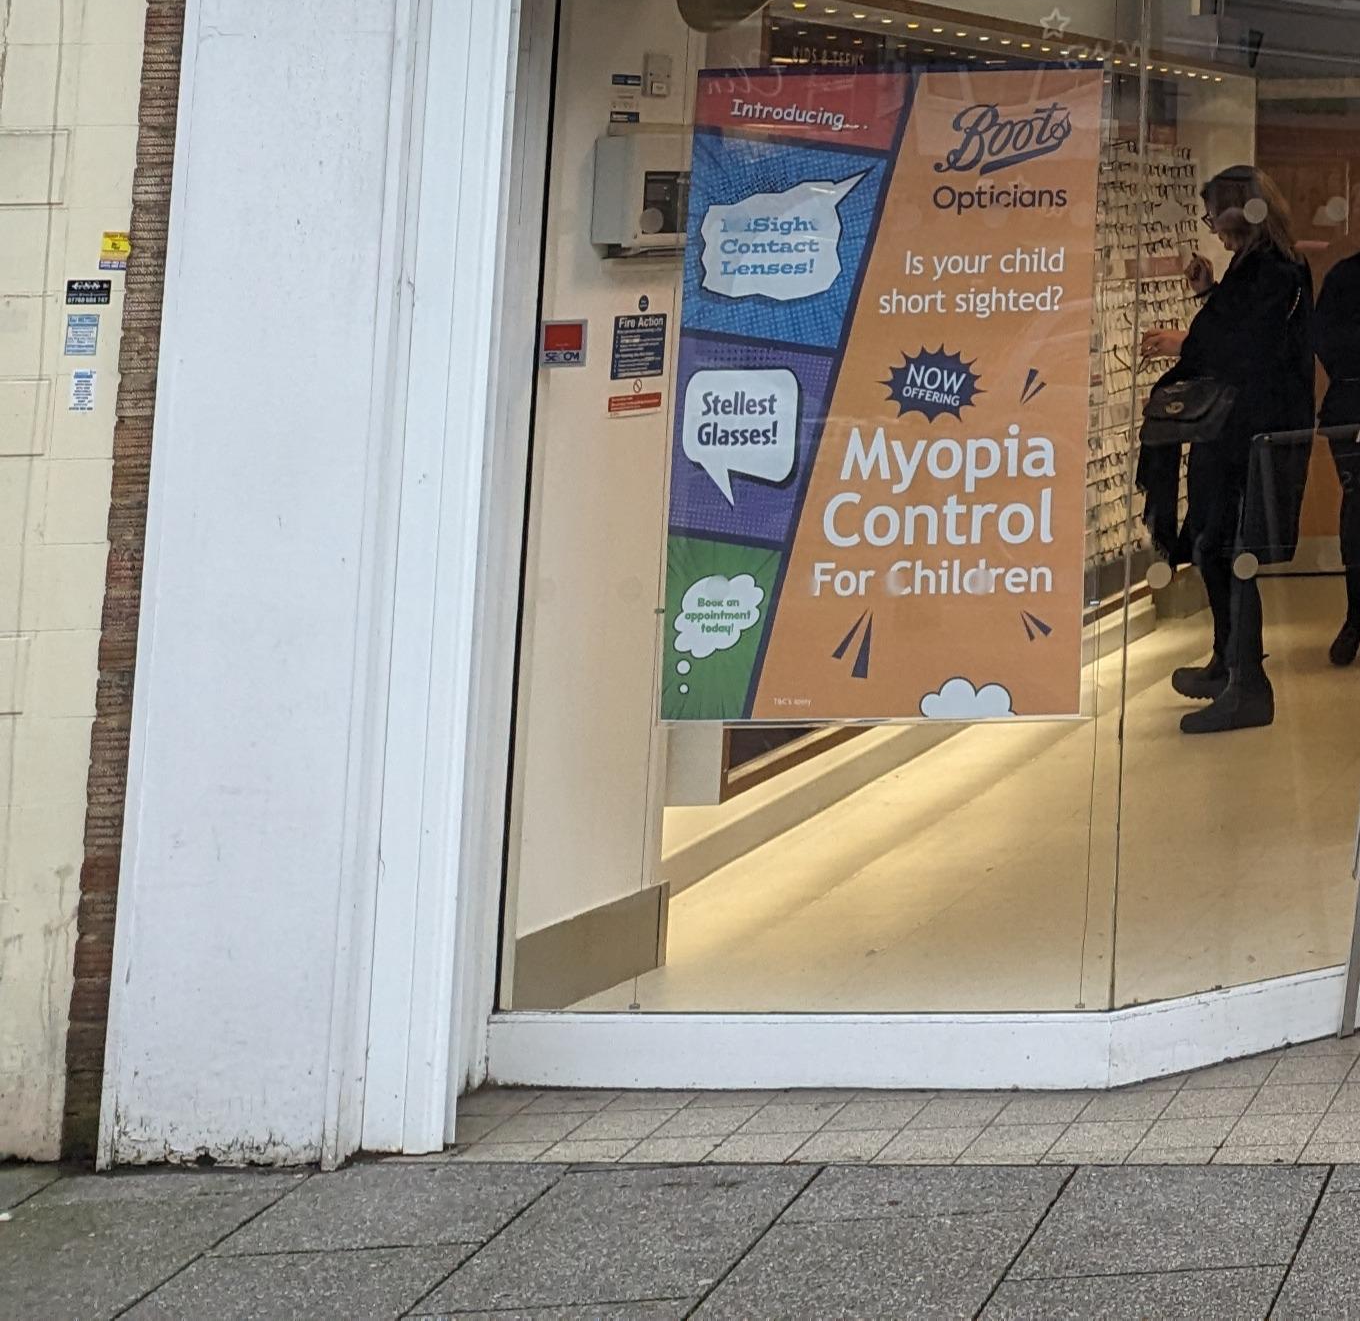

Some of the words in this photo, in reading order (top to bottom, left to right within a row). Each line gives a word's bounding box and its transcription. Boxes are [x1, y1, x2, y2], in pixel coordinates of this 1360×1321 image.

[934, 102, 1073, 175] Boots
[933, 185, 1068, 214] Opticians
[720, 238, 820, 255] Contact
[720, 258, 815, 276] Lenses!
[905, 251, 924, 274] Is
[933, 255, 991, 280] your
[999, 247, 1066, 273] child
[879, 290, 946, 315] short
[955, 286, 1064, 318] sighted?
[619, 318, 636, 329] Fire
[638, 317, 664, 329] Action
[905, 363, 967, 395] NOW
[702, 391, 777, 417] Stellest
[902, 385, 961, 407] OFFERING
[697, 421, 778, 447] Glasses!
[839, 423, 1056, 493] Myopia
[822, 488, 1054, 548] Control
[811, 562, 876, 597] For
[726, 598, 740, 608] an
[684, 609, 752, 624] appointment
[701, 622, 735, 637] today!
